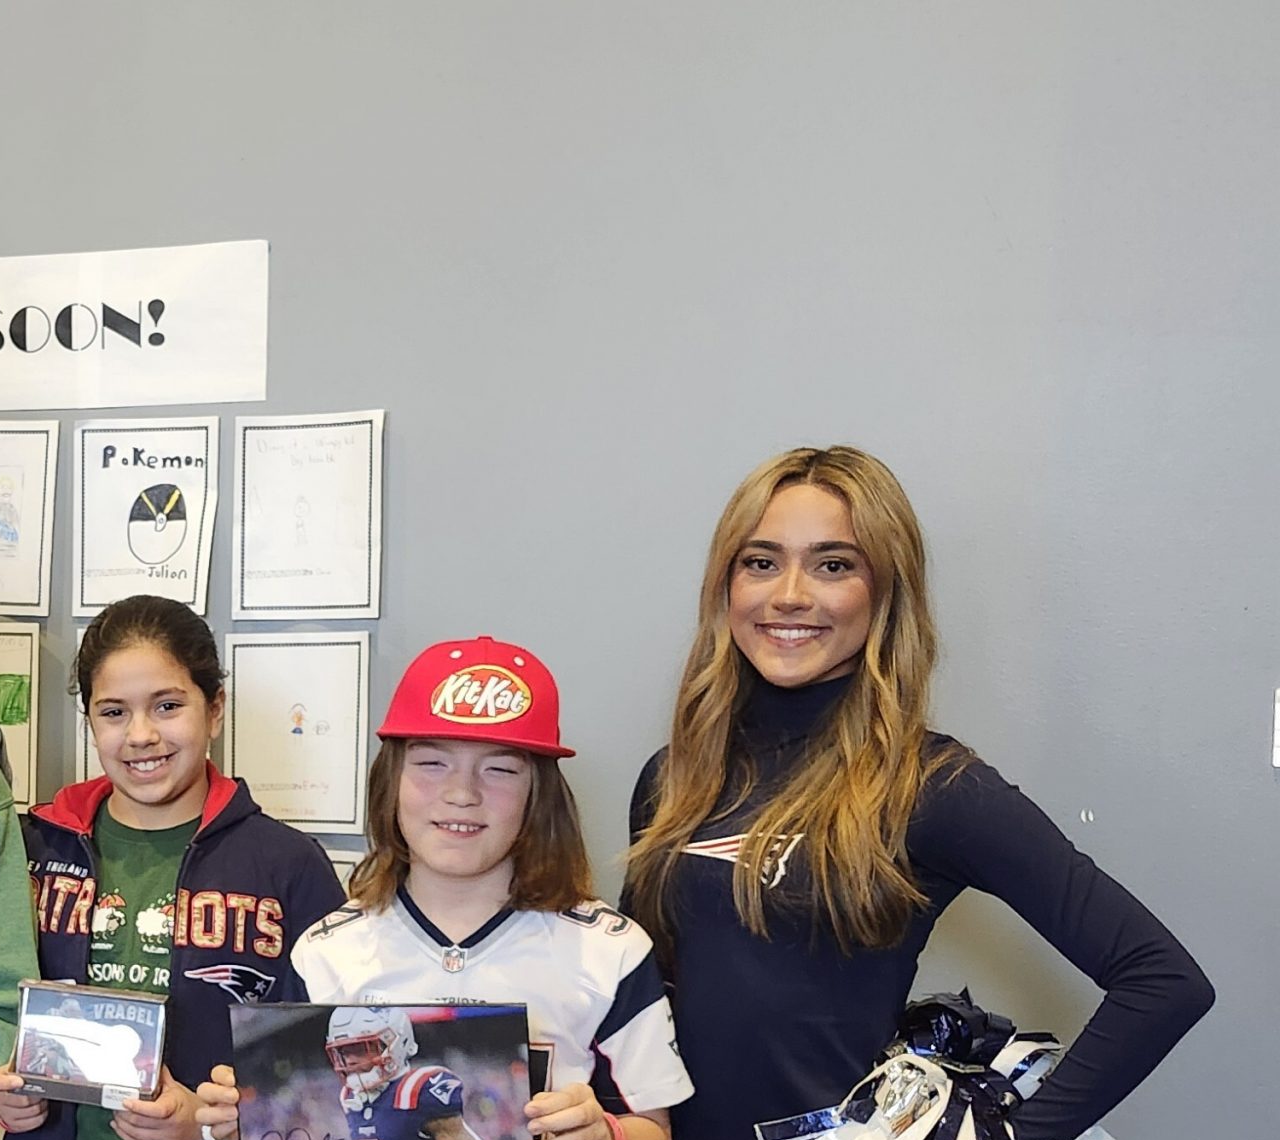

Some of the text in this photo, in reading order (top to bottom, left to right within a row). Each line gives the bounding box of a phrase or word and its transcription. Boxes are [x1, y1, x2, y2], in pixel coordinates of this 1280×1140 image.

[46, 861, 89, 877] ENGLAND
[129, 964, 150, 983] OF
[93, 1003, 155, 1026] VRABEL
